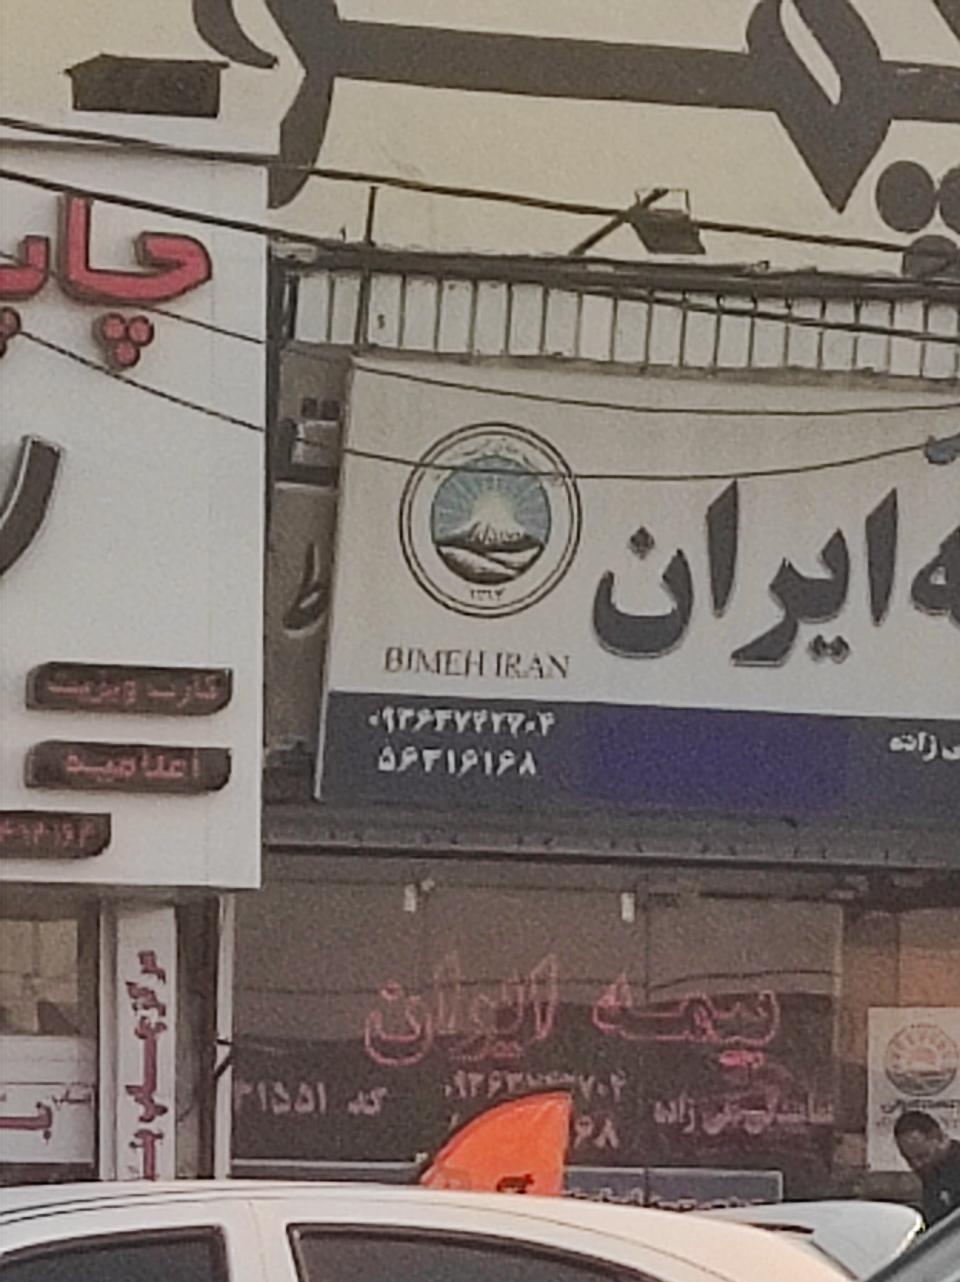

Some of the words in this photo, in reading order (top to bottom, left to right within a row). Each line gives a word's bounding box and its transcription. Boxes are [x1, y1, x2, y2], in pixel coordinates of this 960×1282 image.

[592, 479, 898, 667] ایران
[385, 646, 484, 677] BIMEH
[496, 651, 570, 679] IRAN
